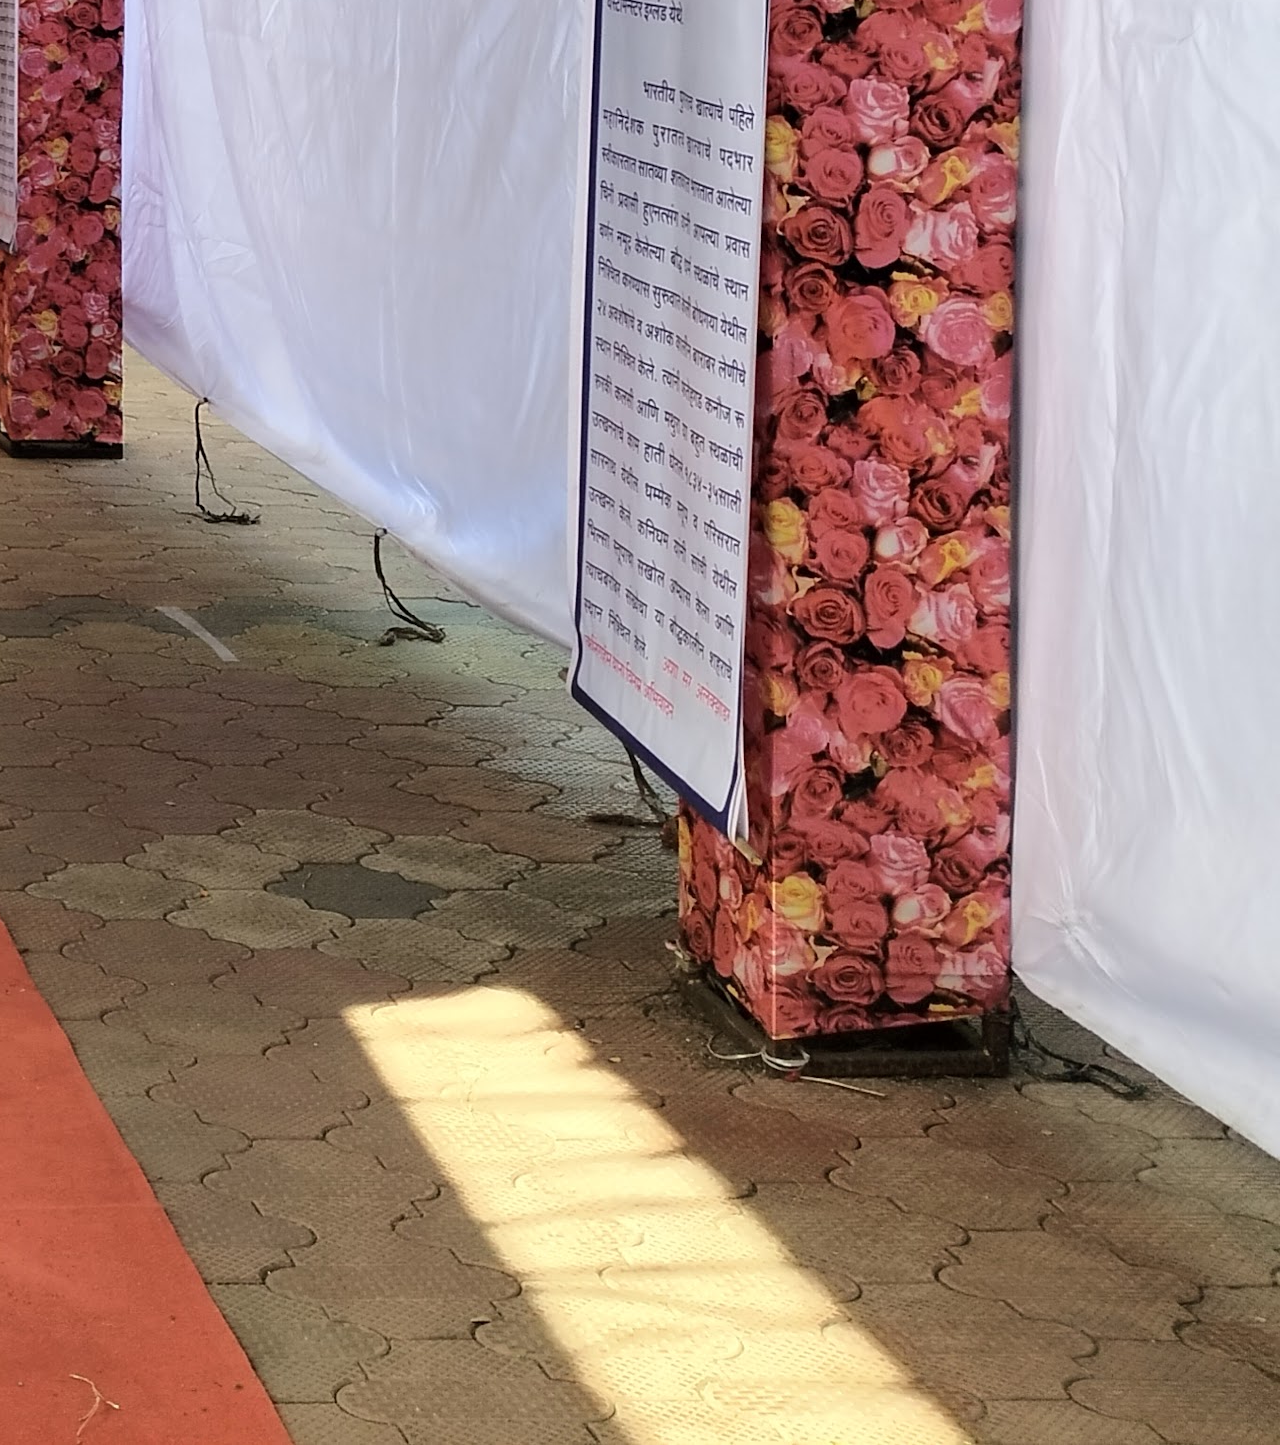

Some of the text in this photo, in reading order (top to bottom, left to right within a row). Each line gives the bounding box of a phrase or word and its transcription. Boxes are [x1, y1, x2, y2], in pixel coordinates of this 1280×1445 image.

[643, 79, 675, 104] भारतीय
[729, 103, 754, 131] पहिले
[719, 148, 754, 173] पदभार
[716, 187, 752, 216] आलेल्या
[725, 235, 750, 258] प्रवास
[724, 277, 749, 301] स्थान
[645, 321, 674, 346] अशोक
[720, 311, 747, 345] येथील
[637, 398, 660, 423] आणि
[644, 442, 665, 466] हाती
